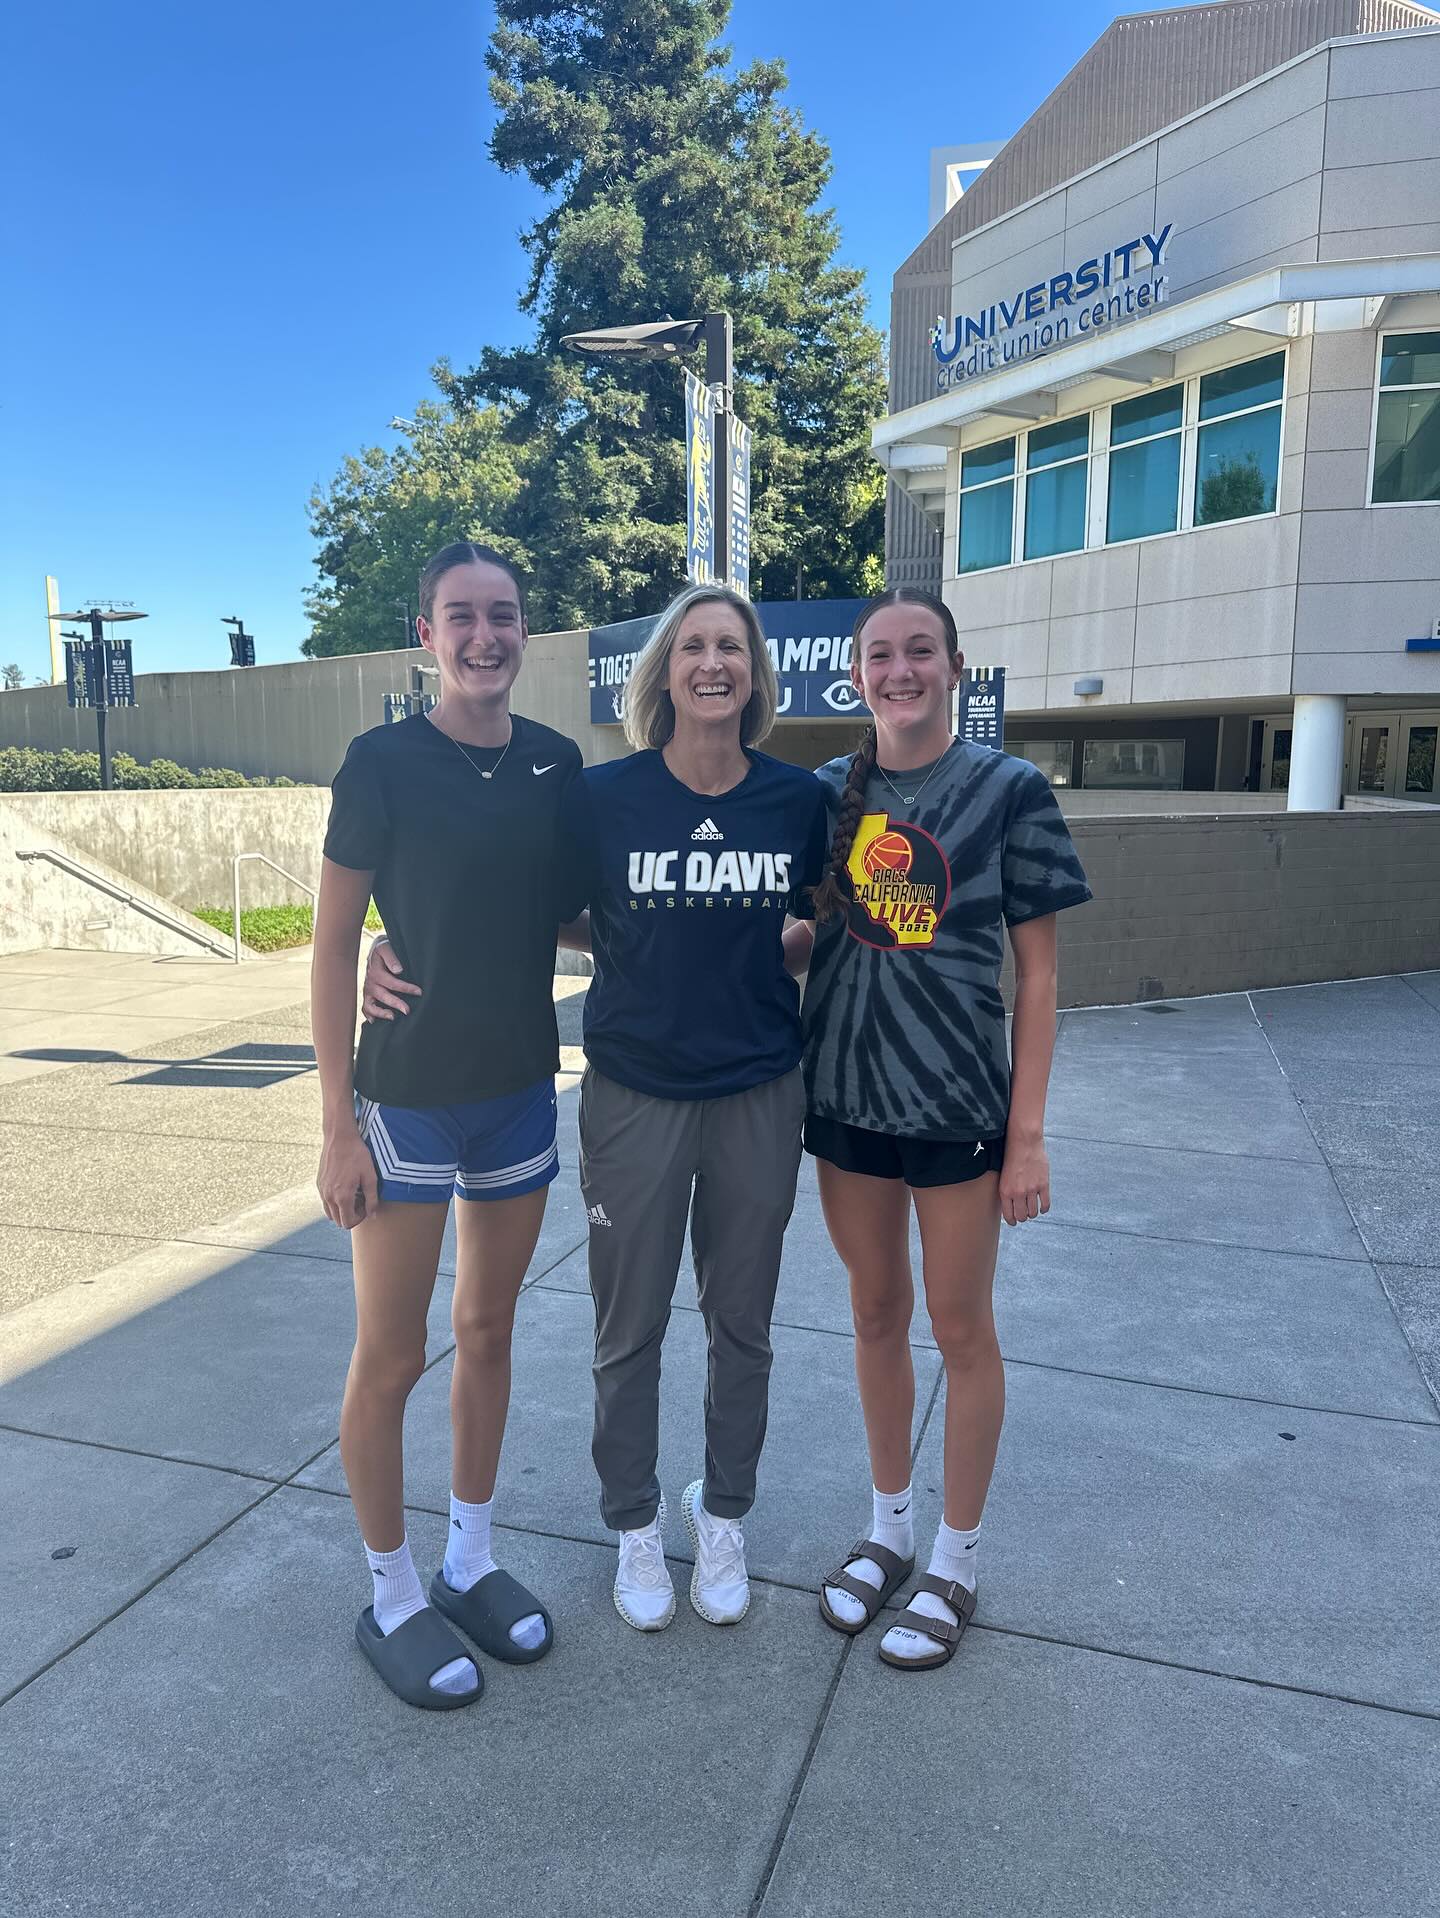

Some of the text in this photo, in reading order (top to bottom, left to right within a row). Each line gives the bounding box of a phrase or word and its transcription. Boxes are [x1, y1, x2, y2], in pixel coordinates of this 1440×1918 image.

[929, 223, 1174, 363] UNIVERSITY
[937, 276, 1166, 388] credit union center
[599, 651, 641, 686] TOGET
[968, 695, 996, 706] NCAA
[691, 832, 724, 841] adidas
[628, 850, 792, 893] UC DAVIS
[873, 868, 907, 883] GIRLS
[853, 884, 936, 904] CALIFORNIA
[877, 903, 933, 923] LIVE
[899, 924, 929, 932] 2025
